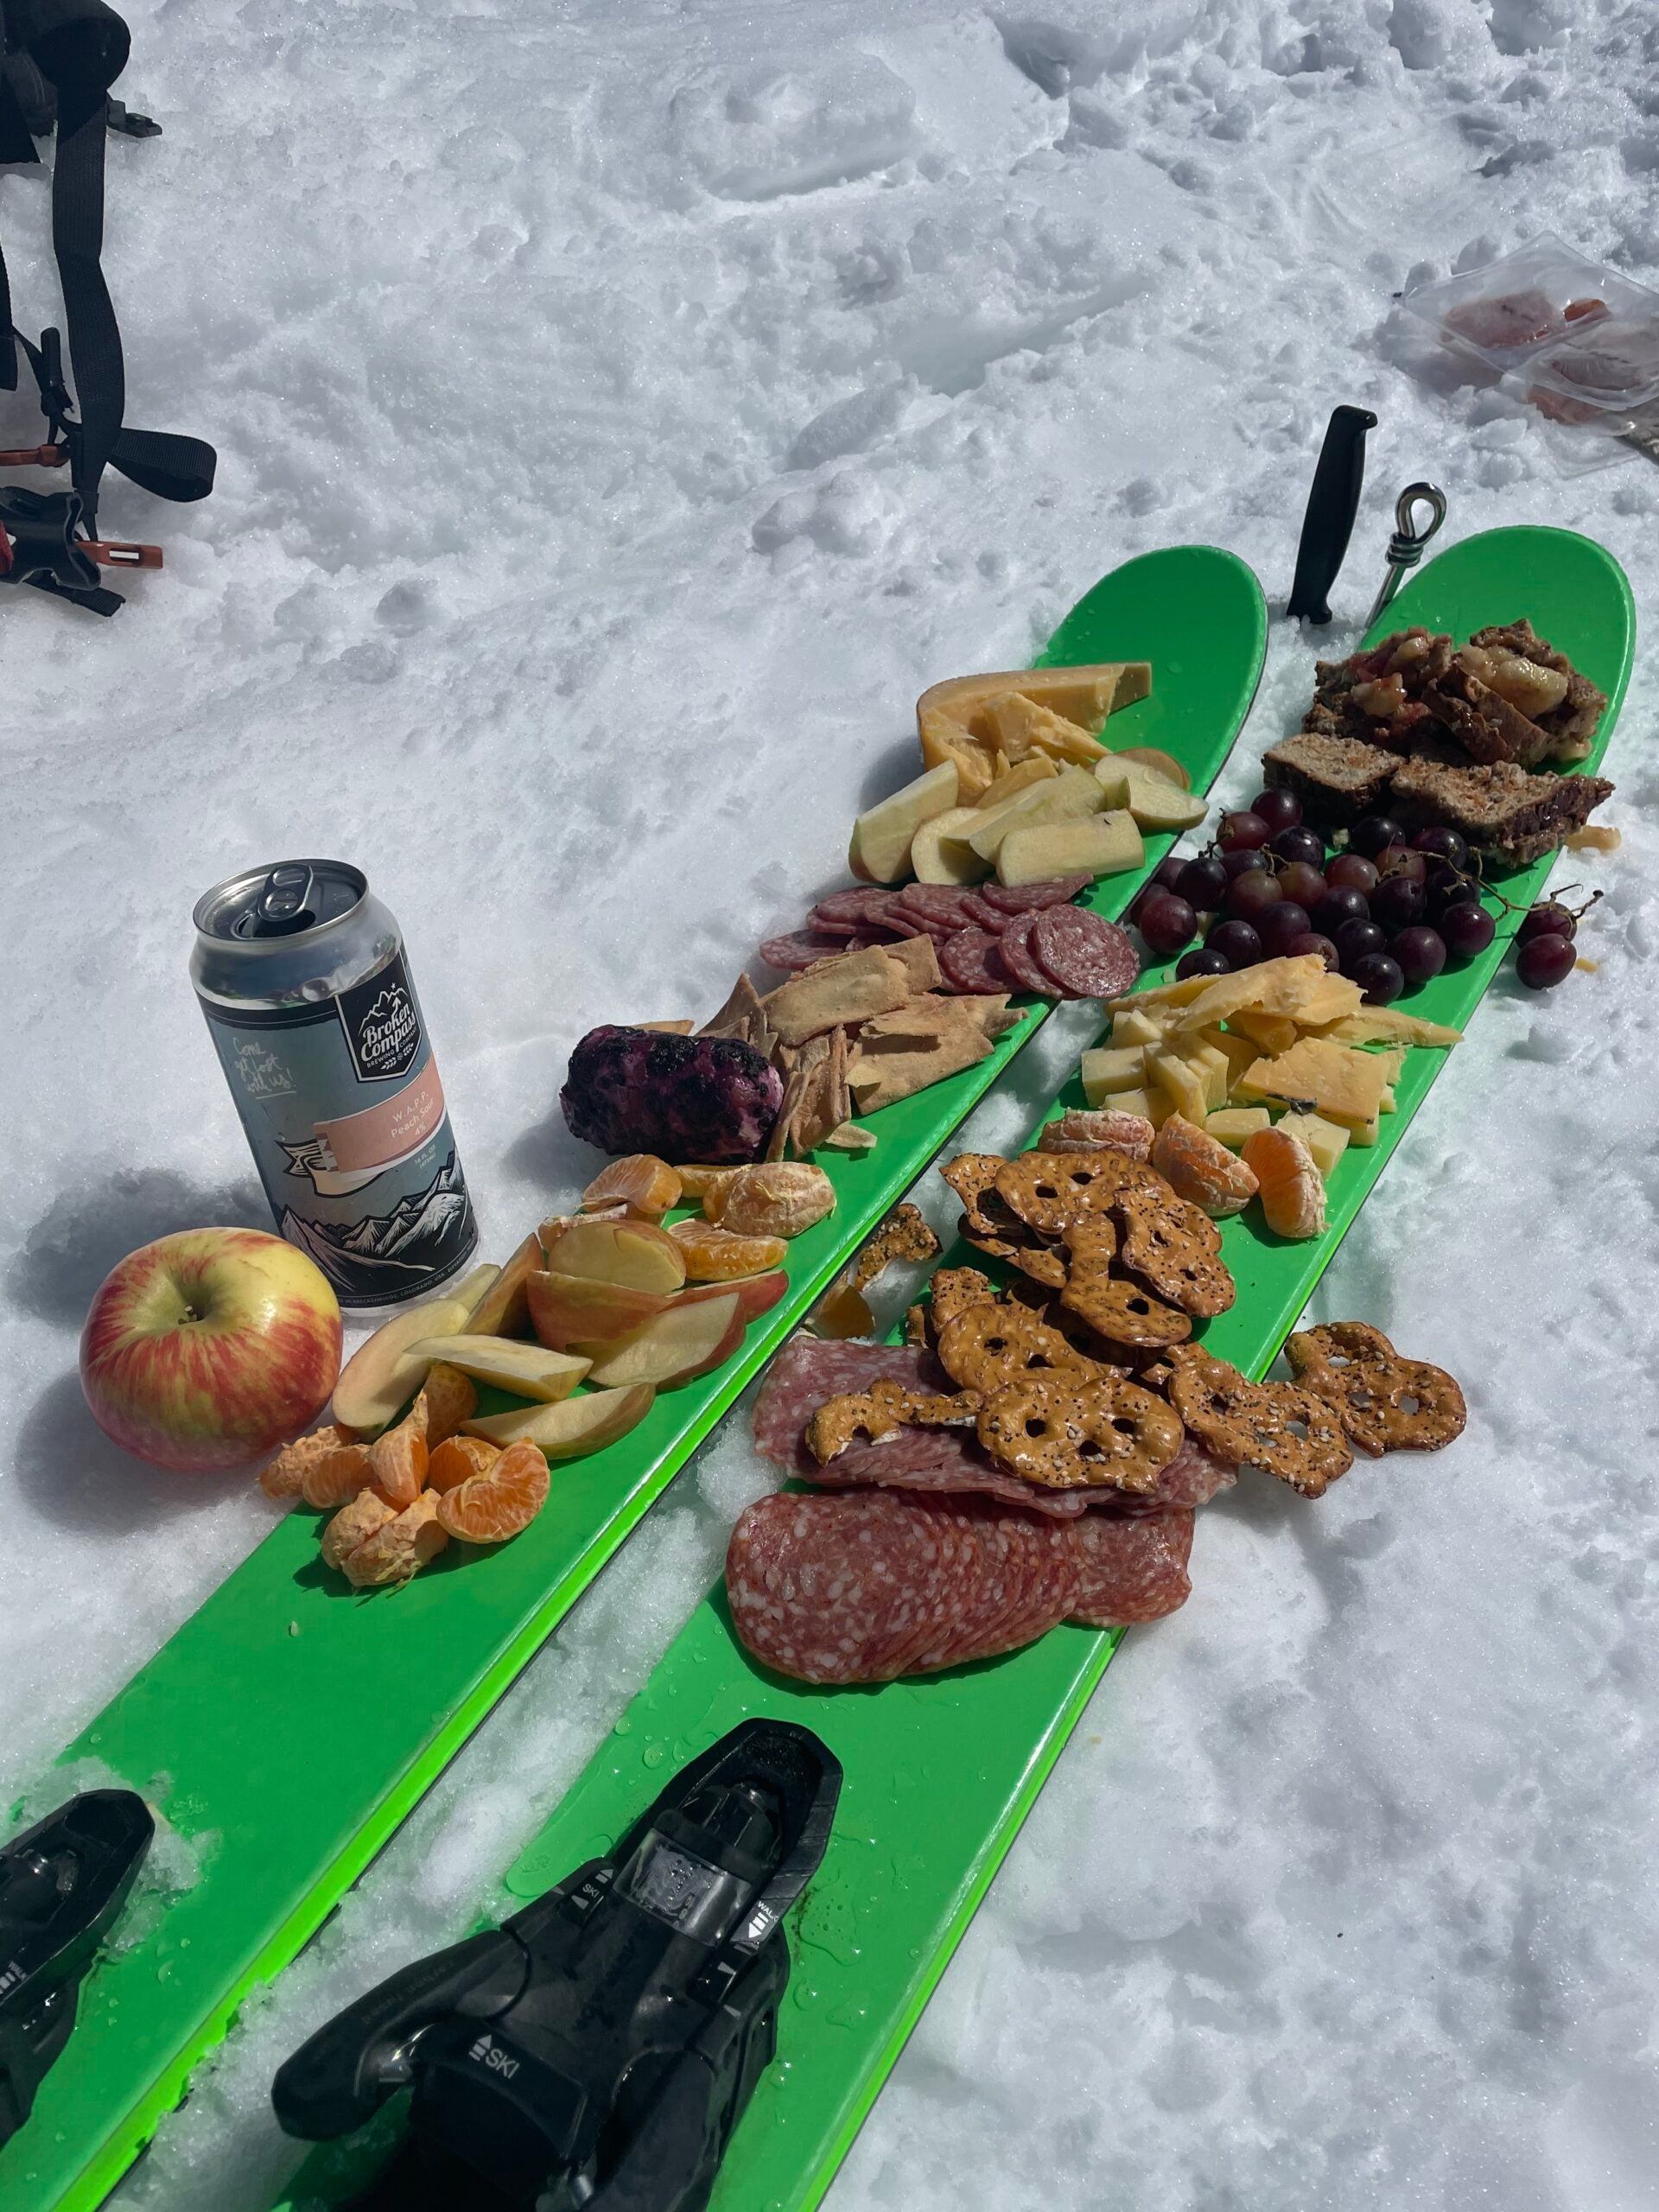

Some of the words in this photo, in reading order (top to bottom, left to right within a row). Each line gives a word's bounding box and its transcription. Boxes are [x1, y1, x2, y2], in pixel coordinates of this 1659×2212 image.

[361, 1011, 416, 1061] Compass
[363, 1001, 410, 1047] Broken
[232, 1037, 267, 1056] Come
[399, 1027, 416, 1048] COMPANY
[366, 1049, 395, 1068] BREWING
[391, 1114, 420, 1138] Peach
[419, 1097, 435, 1118] Sour
[392, 1091, 429, 1122] W.A.P.P.
[414, 1122, 426, 1136] 4%
[582, 1884, 601, 1898] SKI
[485, 2048, 520, 2079] SKI
